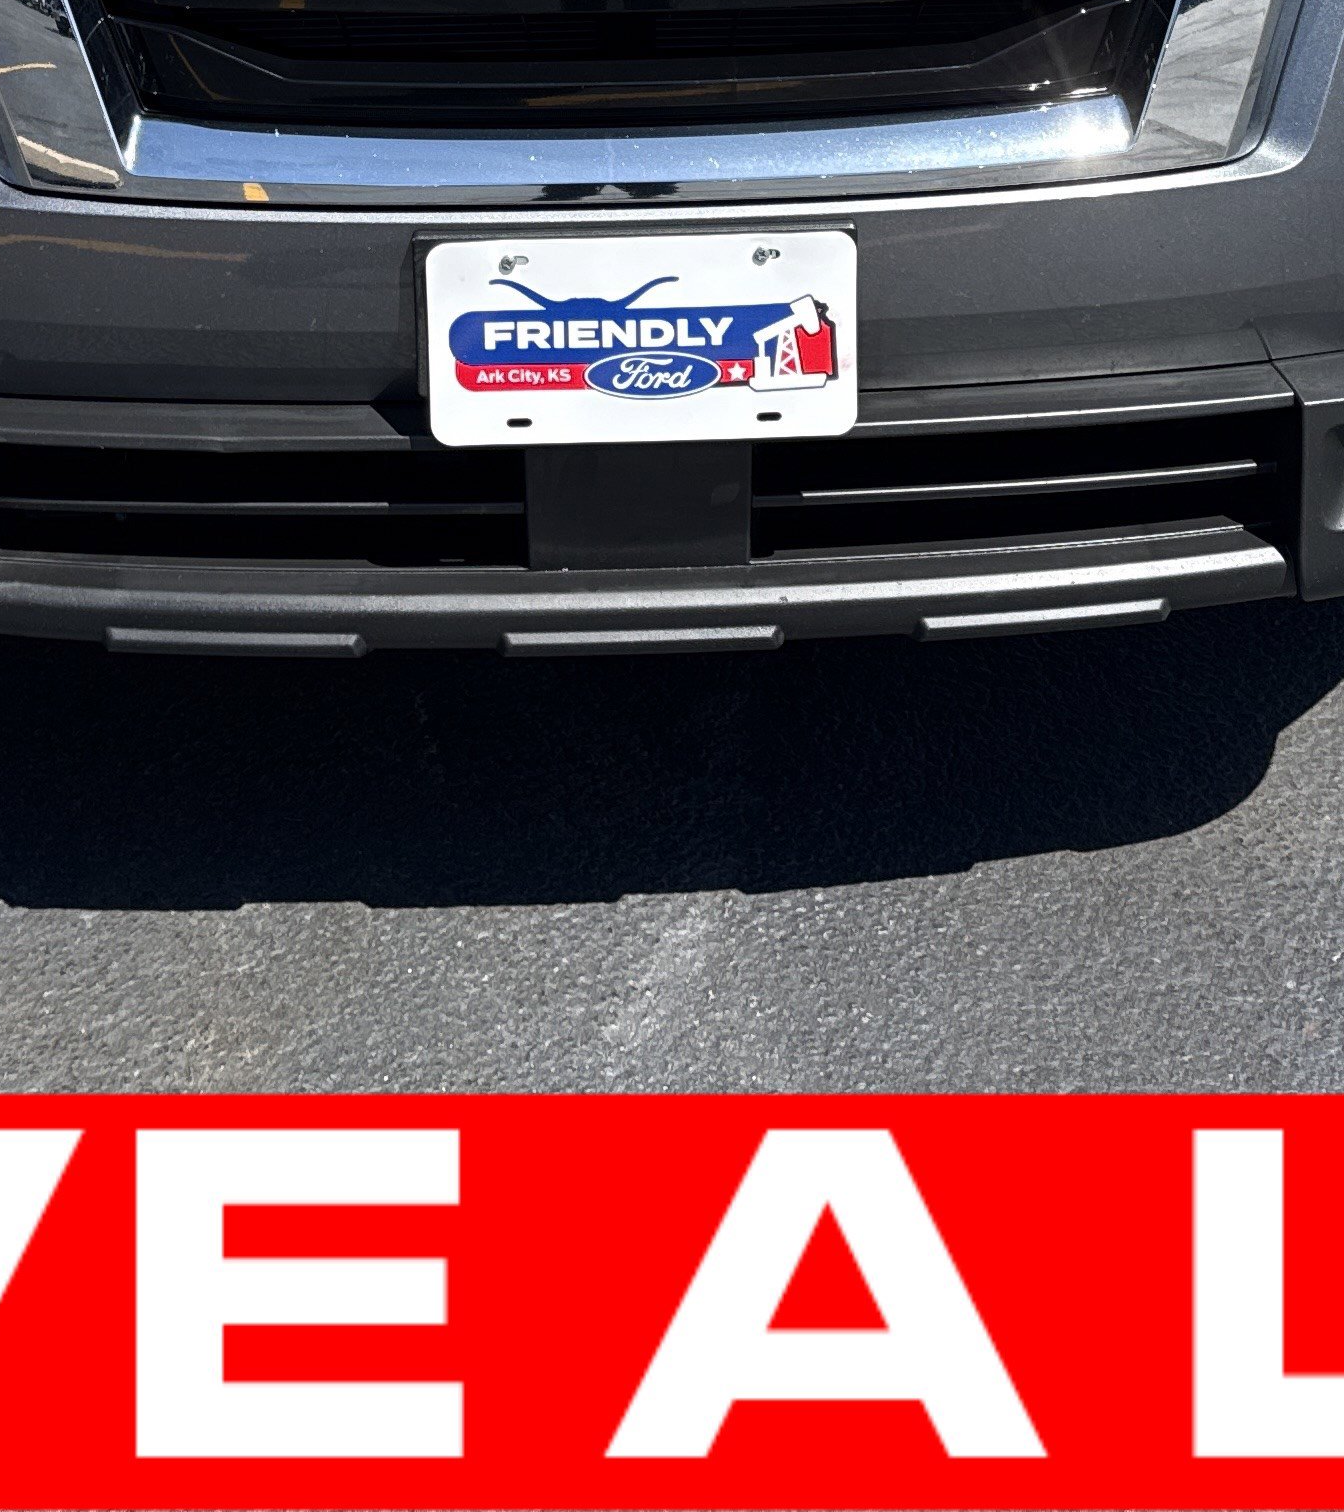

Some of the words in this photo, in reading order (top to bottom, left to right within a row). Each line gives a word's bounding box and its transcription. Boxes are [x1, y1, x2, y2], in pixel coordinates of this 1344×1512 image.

[483, 316, 734, 350] FRIENDLY
[476, 368, 505, 385] Ark
[507, 368, 547, 386] City,
[547, 367, 572, 383] KS
[612, 358, 693, 390] Ford
